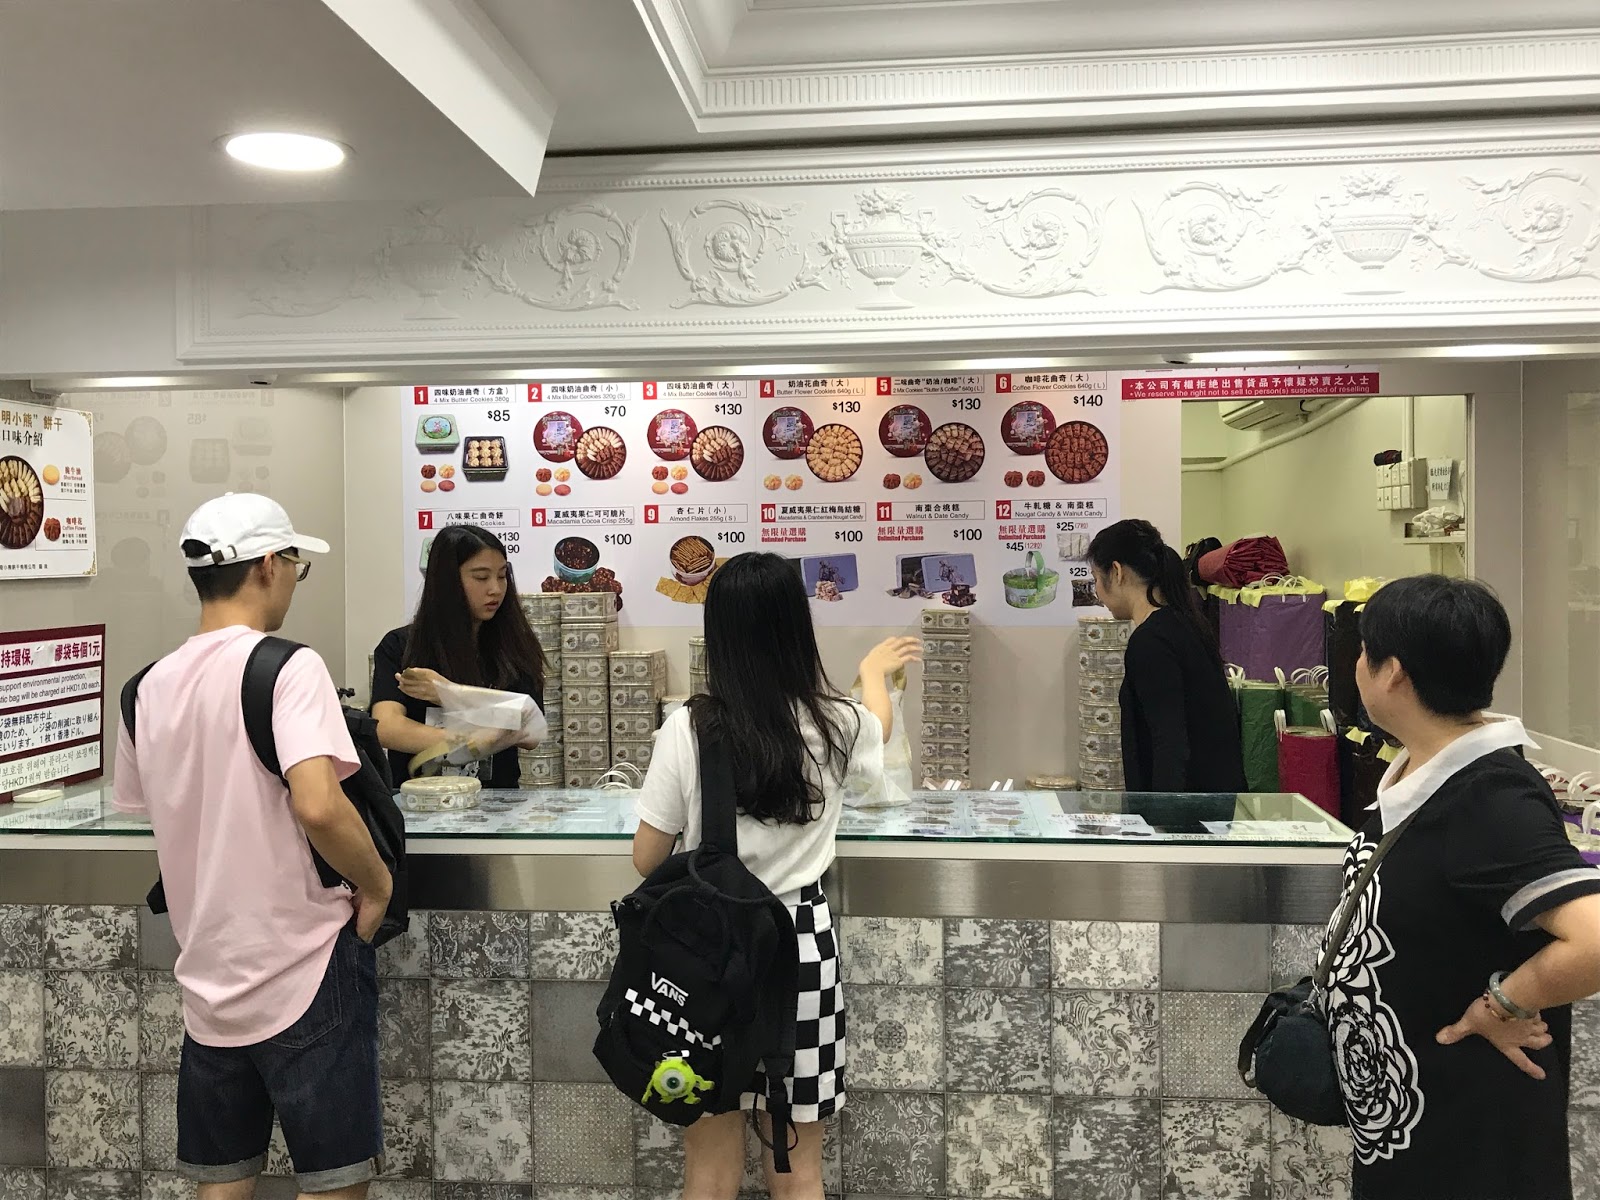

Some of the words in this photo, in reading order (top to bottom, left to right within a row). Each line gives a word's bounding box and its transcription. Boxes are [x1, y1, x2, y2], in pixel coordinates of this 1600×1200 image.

[764, 382, 771, 395] 4
[880, 379, 888, 392] 5
[999, 376, 1008, 389] 6
[646, 384, 654, 397] 3
[1291, 386, 1328, 394] suspected
[952, 398, 981, 410] $130
[1073, 394, 1103, 407] $140
[604, 405, 627, 417] $70
[714, 403, 742, 415] $130
[832, 401, 861, 413] $130
[487, 409, 511, 422] $85
[647, 508, 656, 521] 9
[762, 507, 775, 520] 10
[879, 506, 890, 519] 11
[949, 512, 969, 520] Candy
[997, 504, 1010, 517] 12
[1083, 510, 1103, 518] Candy
[1056, 522, 1075, 531] $25
[497, 531, 520, 542] $130
[604, 533, 632, 545] $100
[717, 531, 745, 543] $100
[835, 530, 863, 542] $100
[953, 528, 982, 541] $100
[503, 544, 520, 554] 190
[1006, 542, 1024, 551] $45
[1069, 567, 1088, 577] $25
[0, 682, 22, 693] support
[22, 675, 60, 689] environmental
[8, 694, 20, 703] bag
[21, 691, 30, 700] will
[31, 691, 39, 699] be
[39, 687, 60, 698] charged
[60, 686, 66, 694] at
[651, 971, 689, 1007] VANS
